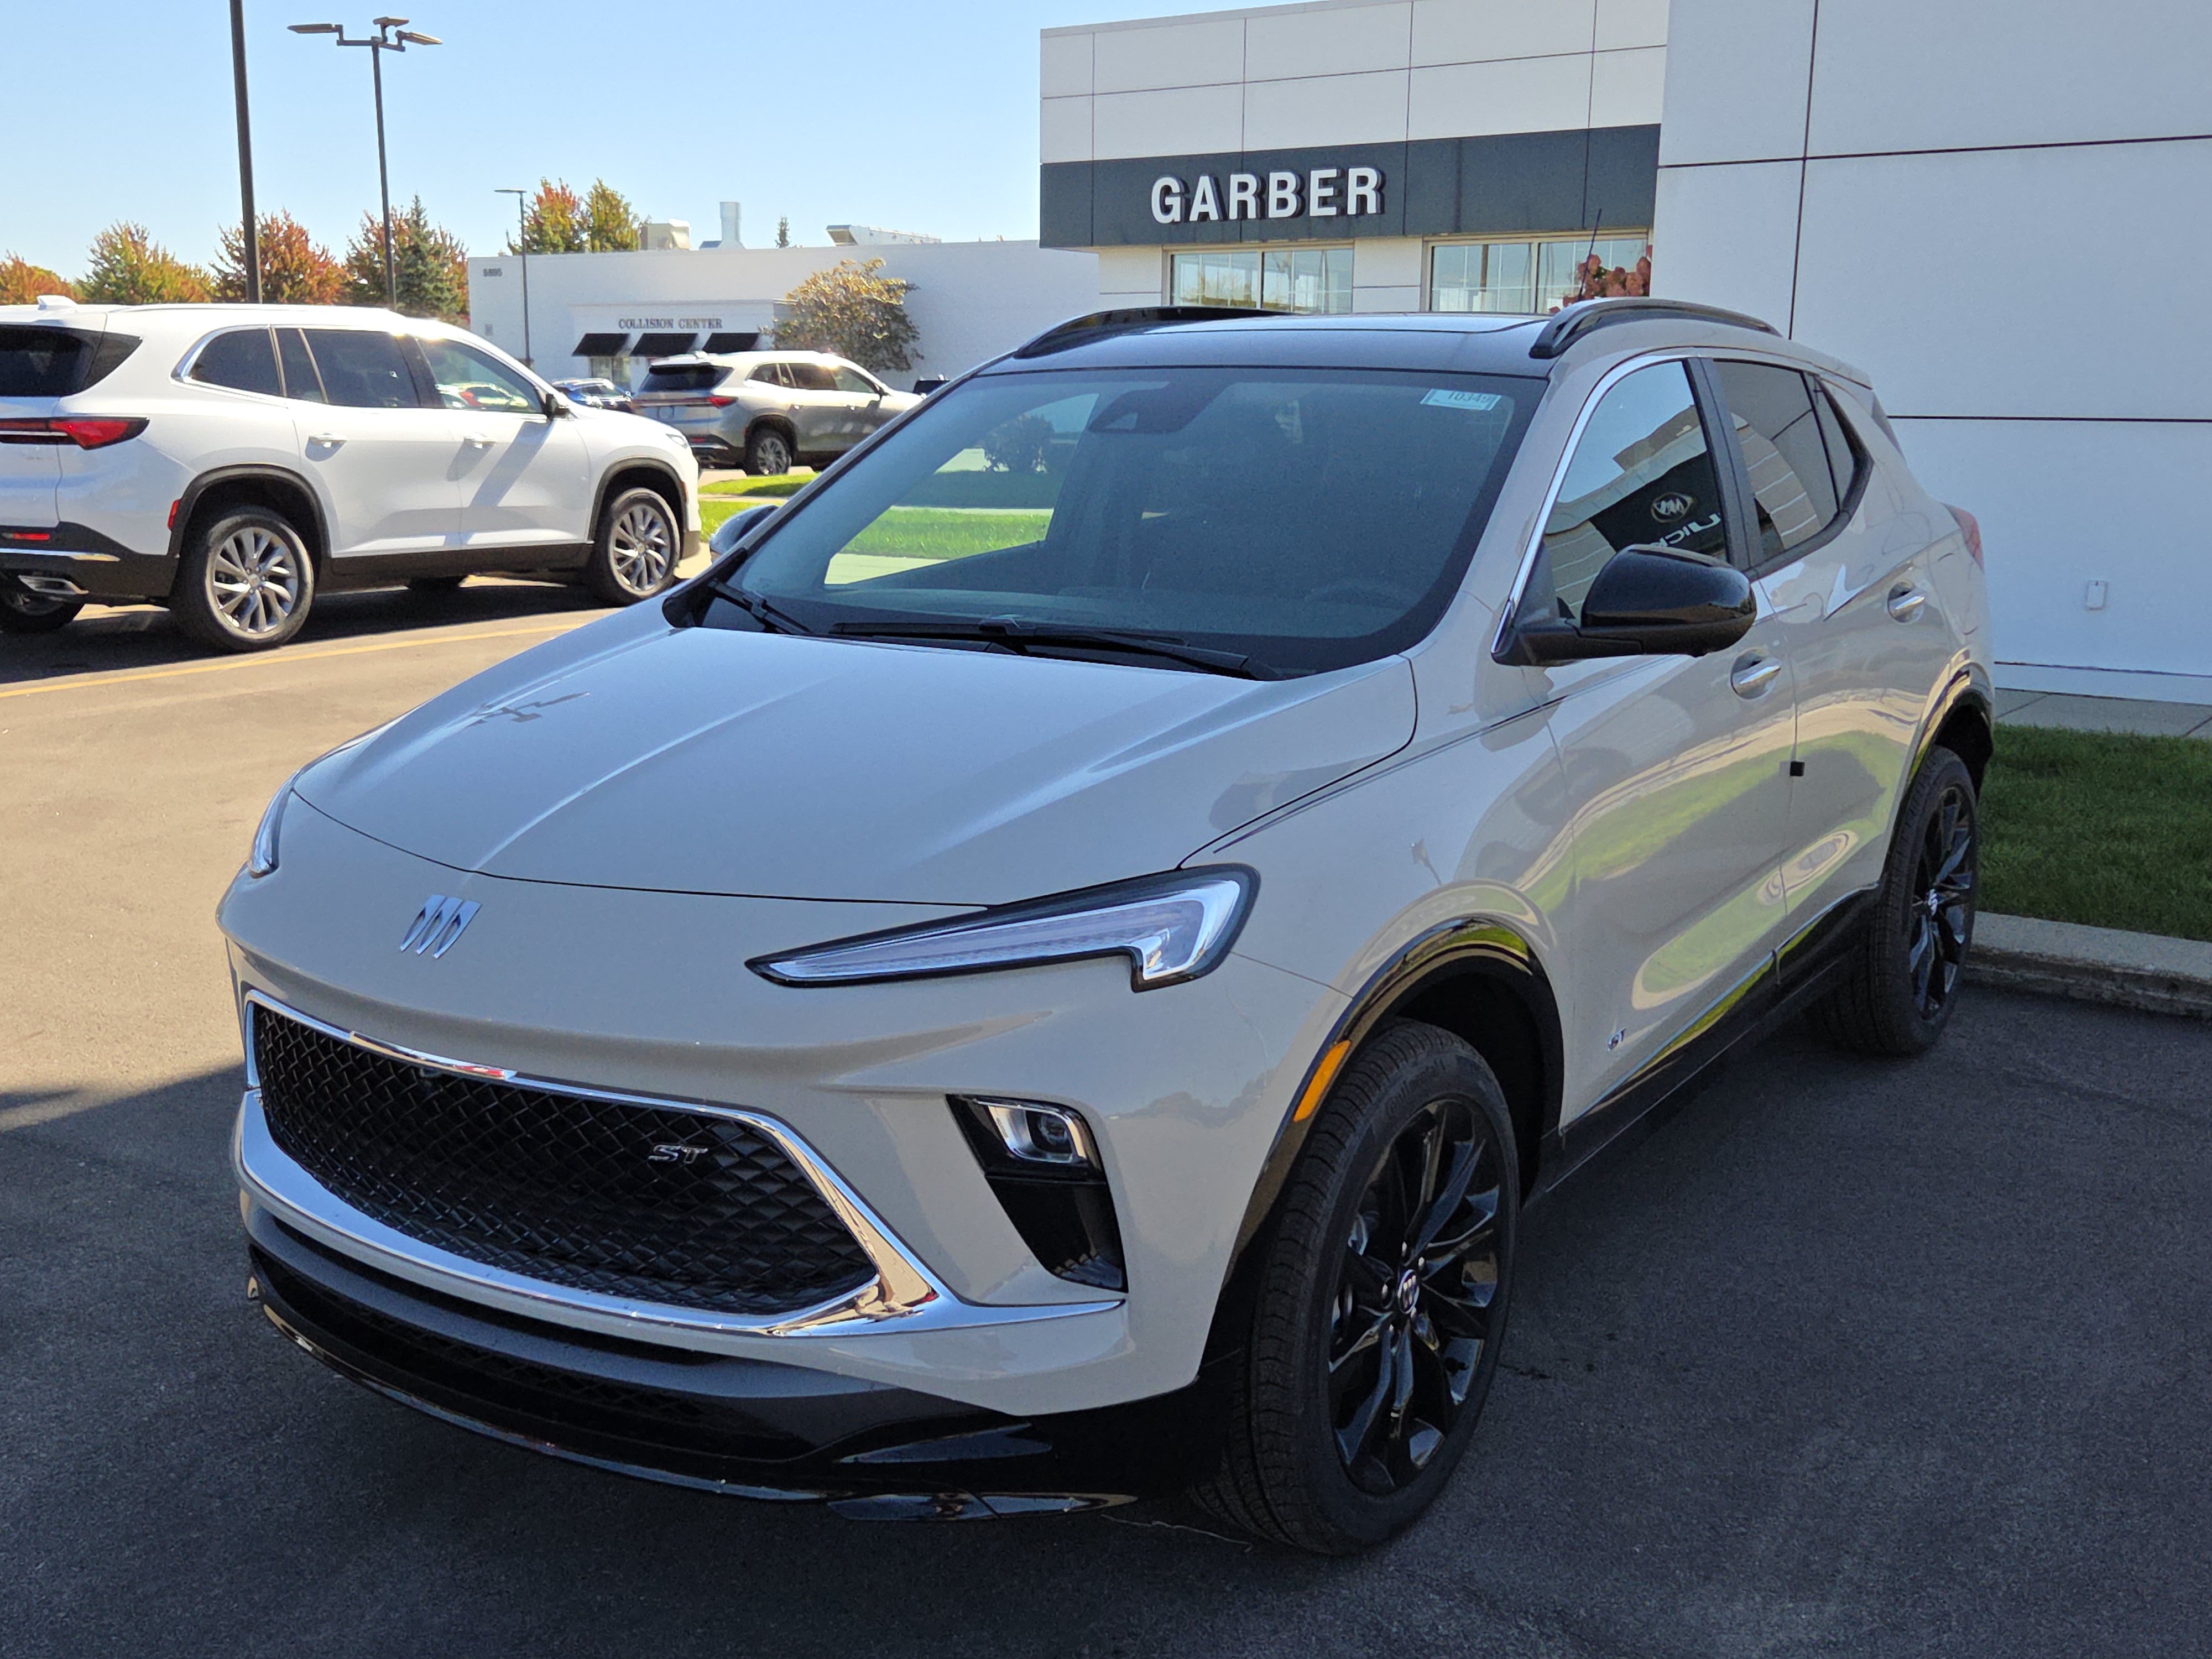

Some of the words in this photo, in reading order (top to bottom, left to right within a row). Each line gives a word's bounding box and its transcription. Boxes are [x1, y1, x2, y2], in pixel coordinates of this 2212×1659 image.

[1151, 167, 1383, 225] GARBER
[618, 319, 674, 328] COLLISION
[679, 319, 722, 328] CENTER
[648, 1144, 709, 1164] ST
